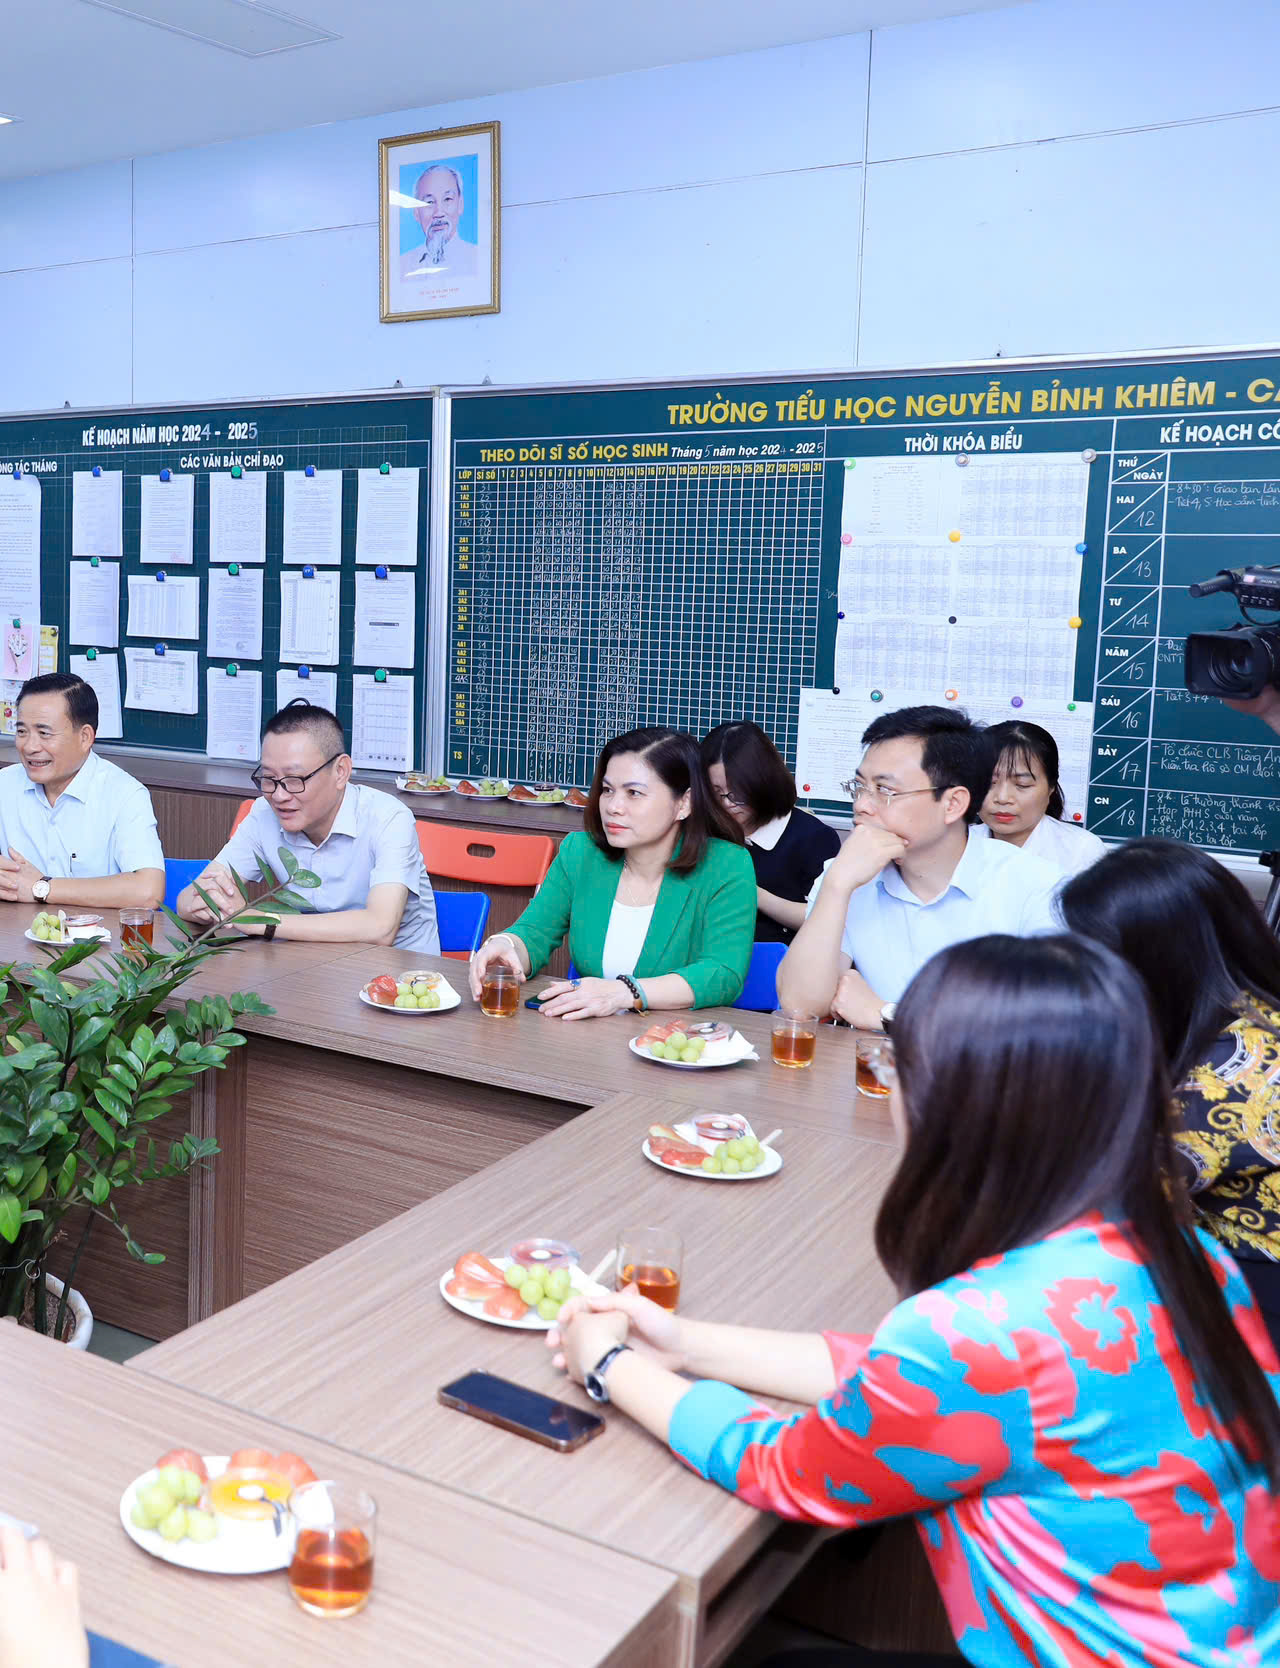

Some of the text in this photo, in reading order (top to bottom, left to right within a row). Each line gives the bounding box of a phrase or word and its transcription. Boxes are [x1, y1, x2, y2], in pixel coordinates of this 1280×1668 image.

[667, 392, 768, 424] TRƯỜNG
[775, 389, 825, 421] TIỂU
[834, 396, 897, 423] HỌC
[905, 381, 1021, 417] NGUYỄN
[1031, 379, 1103, 413] BỈNH
[1115, 376, 1216, 408] KHIÊM
[82, 425, 96, 446] KẾ
[97, 429, 129, 448] HOẠCH
[132, 424, 156, 444] NĂM
[159, 425, 179, 446] HỌC
[182, 423, 211, 441] 2024
[228, 422, 258, 439] 2025
[904, 426, 1023, 452] THỜI KHÓA BIỂU
[1160, 419, 1184, 443] KẾ
[1185, 423, 1253, 446] HOẠCH
[480, 441, 668, 462] THEO DÕI SĨ SỐ HỌC SINH
[671, 445, 703, 459] Tháng
[704, 444, 713, 457] 5
[713, 446, 735, 457] năm
[738, 445, 759, 458] học
[32, 459, 57, 472] THÁNG
[180, 453, 200, 468] CÁC
[203, 452, 221, 467] VĂN
[244, 451, 260, 467] CHỈ
[263, 454, 284, 469] ĐẠO
[1118, 456, 1163, 480] THỨ NGÀY
[458, 470, 471, 479] LỚP
[755, 464, 764, 473] 26
[766, 464, 775, 472] 27
[778, 463, 787, 472] 28
[789, 463, 798, 472] 29
[801, 463, 810, 472] 30
[813, 462, 821, 471] 31
[1116, 496, 1134, 504] HAI
[1134, 511, 1155, 527] 12
[1113, 546, 1127, 554] BA
[1132, 561, 1152, 577] 13
[1109, 597, 1122, 606] TƯ
[1126, 613, 1149, 629] 14
[1105, 647, 1129, 657] NĂM
[1123, 662, 1147, 680] 15
[1101, 695, 1120, 706] SÁU
[1121, 712, 1142, 729] 16
[1098, 745, 1117, 756] BẢY
[1118, 760, 1141, 782] 17
[1094, 797, 1109, 805] CN
[1117, 810, 1135, 826] 18
